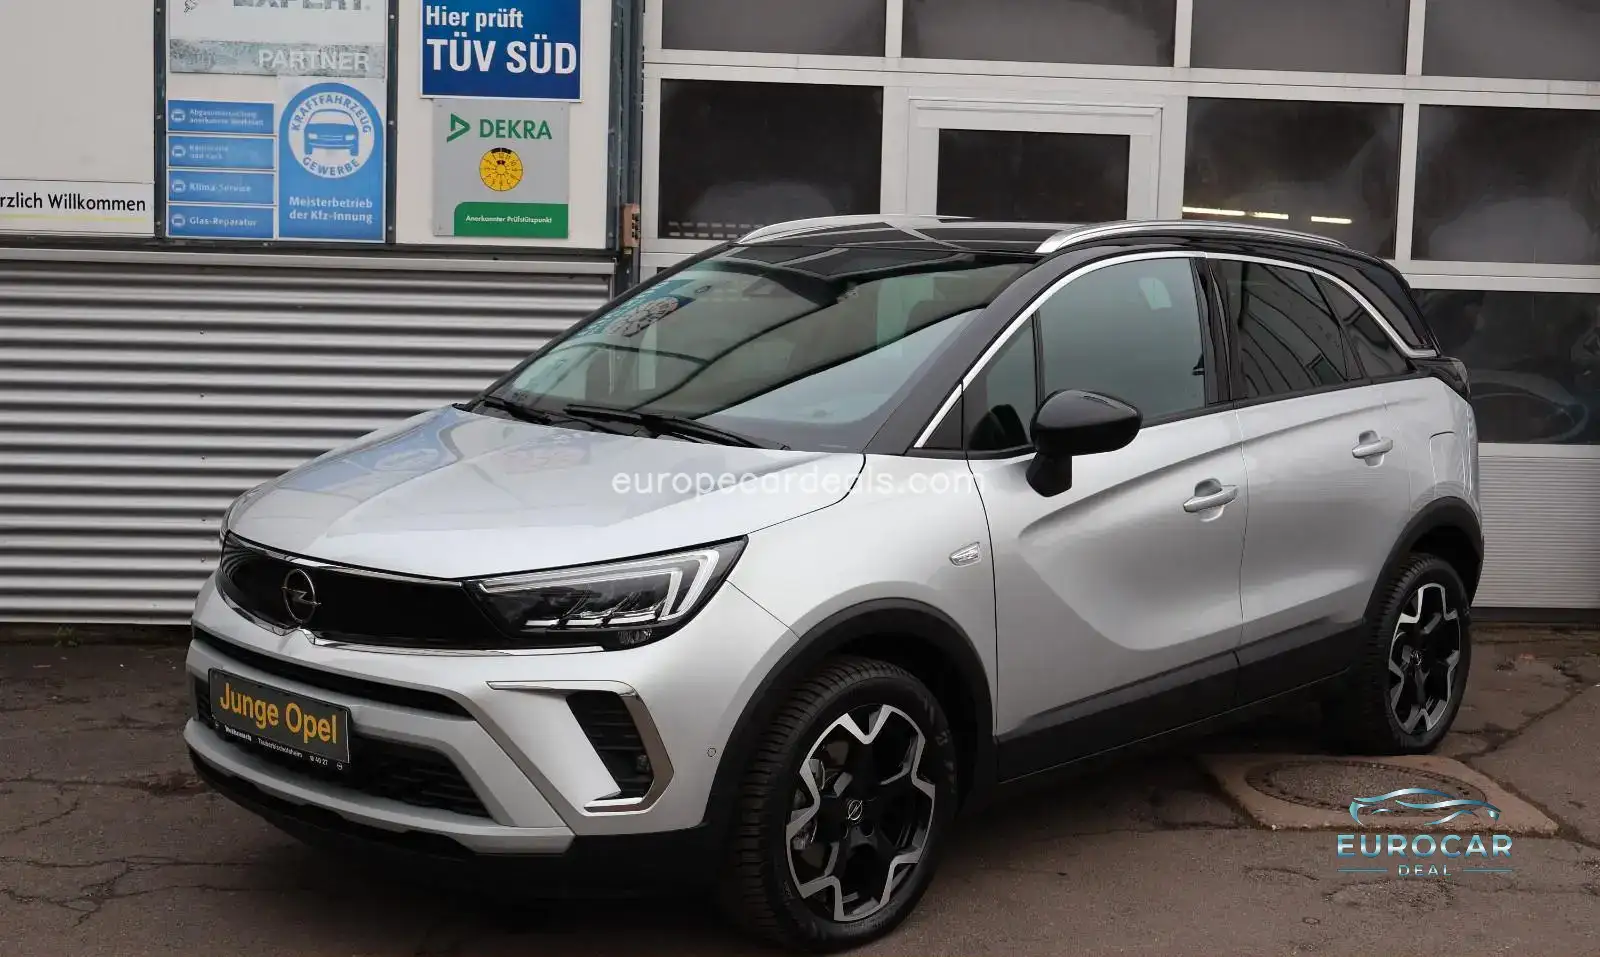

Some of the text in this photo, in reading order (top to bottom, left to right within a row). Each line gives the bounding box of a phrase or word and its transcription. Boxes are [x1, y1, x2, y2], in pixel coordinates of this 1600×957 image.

[426, 5, 524, 32] Hier prüft
[258, 49, 370, 71] PARTNER
[427, 32, 577, 74] TÜV SÜD
[291, 94, 372, 133] KRAFTFAHRZEUG
[479, 118, 553, 140] DEKRA
[302, 156, 360, 176] GEWERBE
[48, 193, 146, 212] Willkommen
[289, 196, 373, 208] Meisterbetrieb
[189, 216, 258, 228] Glas-Reparatur
[289, 209, 374, 224] der Kfz-Innung
[219, 682, 338, 744] Junge Opel
